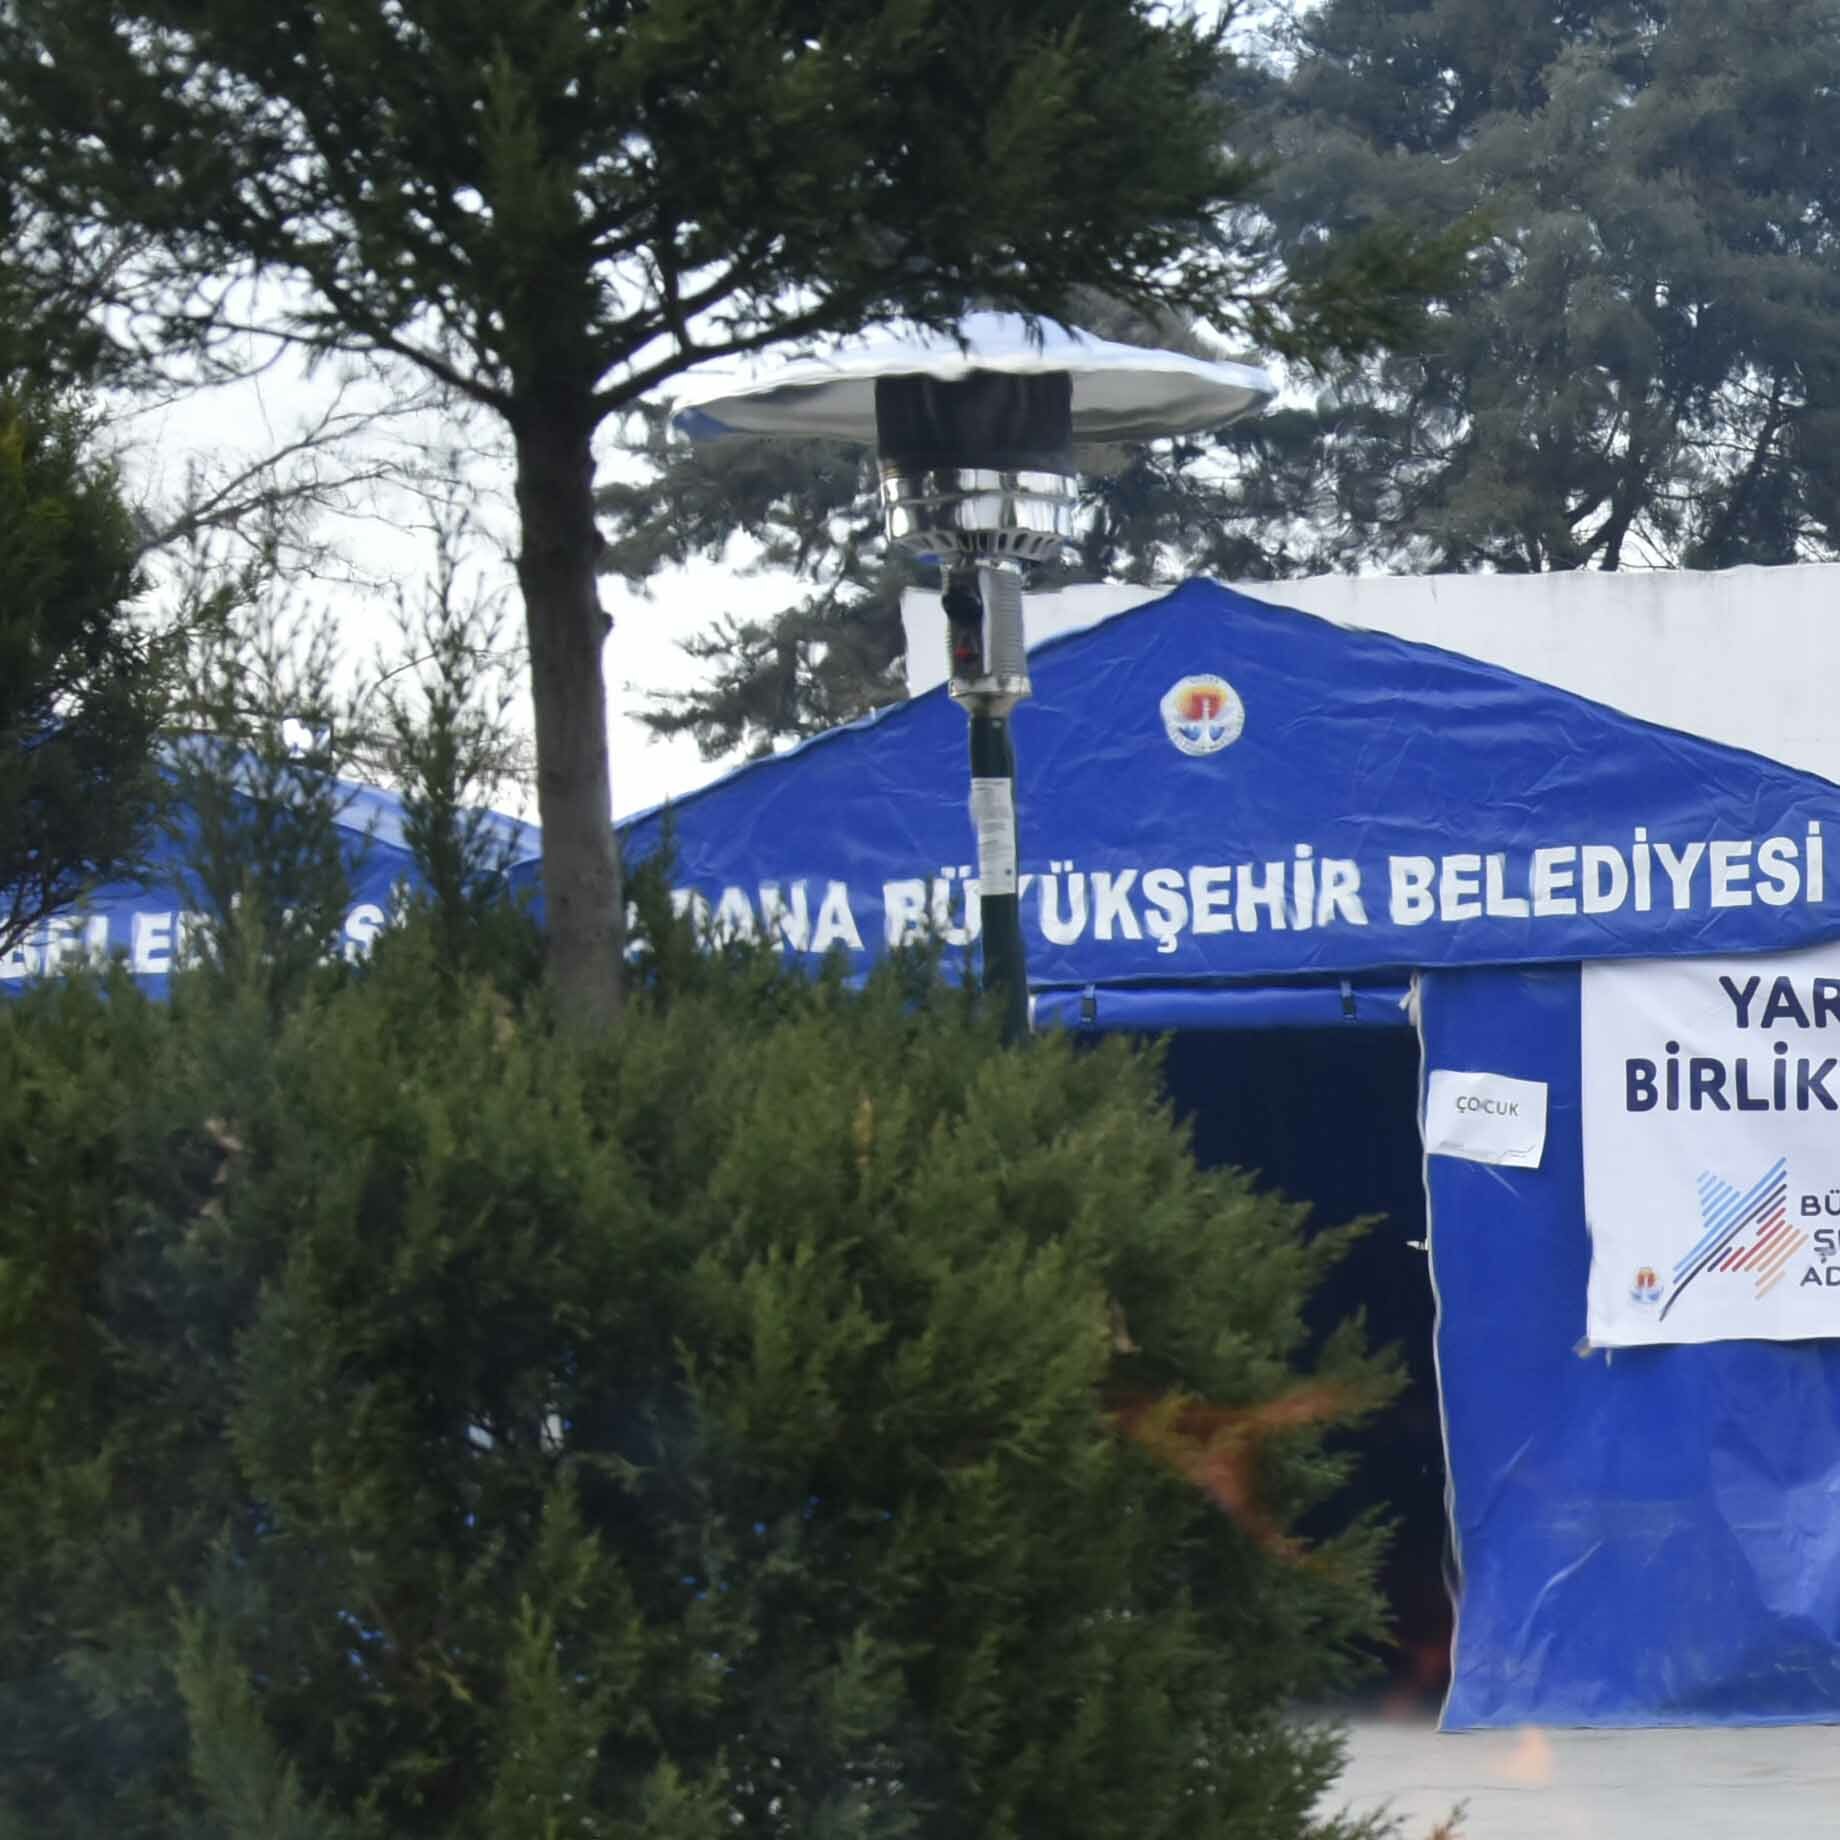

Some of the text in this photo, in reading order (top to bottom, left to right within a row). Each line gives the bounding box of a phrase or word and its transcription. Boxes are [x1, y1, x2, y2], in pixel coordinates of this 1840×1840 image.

[882, 843, 1367, 953] BÜÜKŞEHİR
[1388, 821, 1824, 925] BELEDİYESİ
[1455, 1095, 1520, 1117] ÇOCUK
